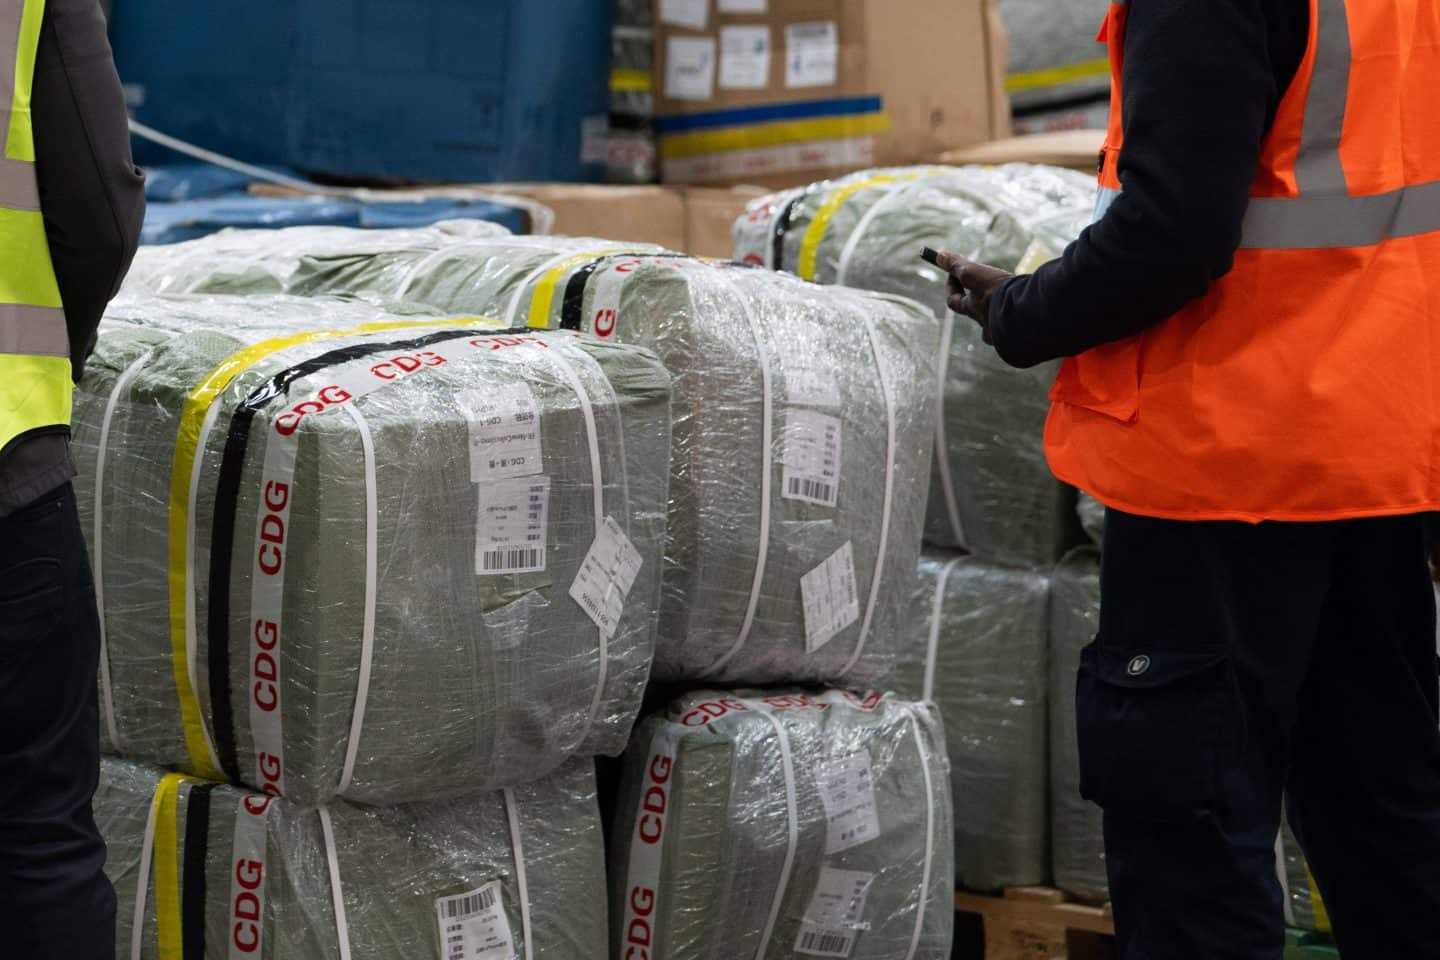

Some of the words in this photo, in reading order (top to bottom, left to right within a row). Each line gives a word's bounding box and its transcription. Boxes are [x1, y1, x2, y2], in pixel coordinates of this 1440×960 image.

[274, 385, 352, 436] CDG
[370, 350, 447, 380] CDG
[260, 479, 289, 576] CDG
[254, 618, 278, 712] CDG
[681, 699, 749, 727] CDG
[639, 754, 673, 845] CDG
[234, 857, 263, 953] CDG
